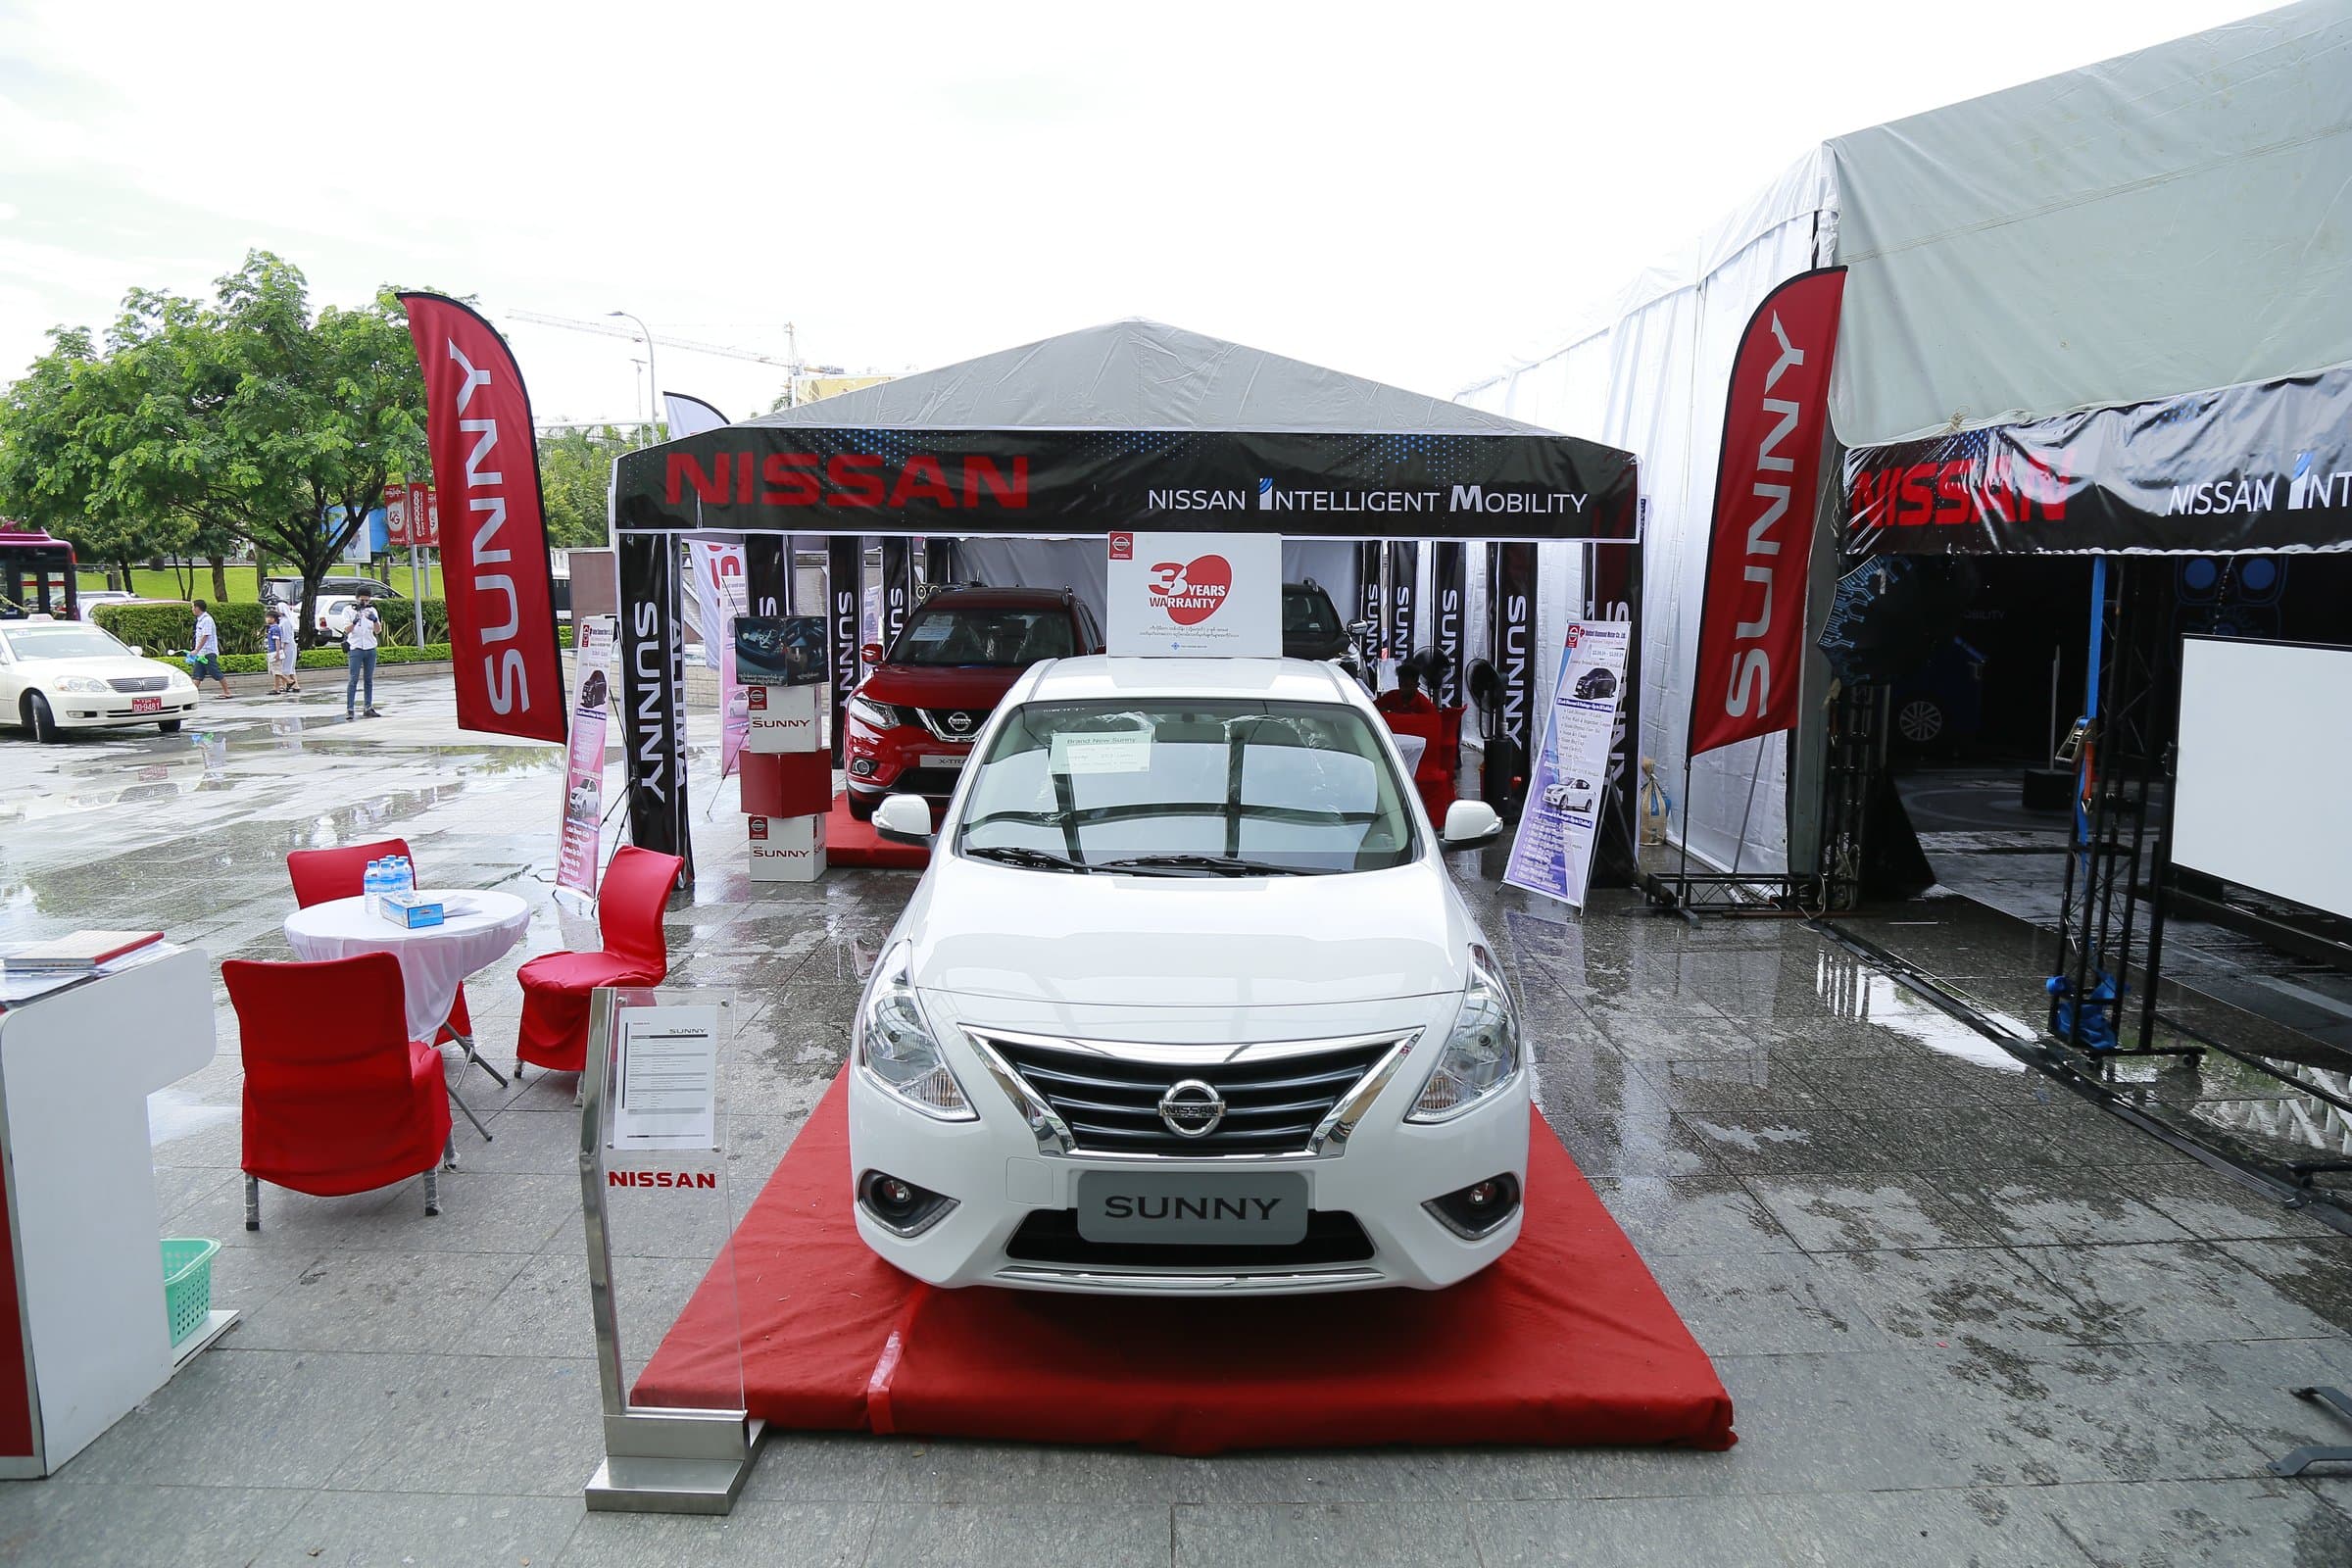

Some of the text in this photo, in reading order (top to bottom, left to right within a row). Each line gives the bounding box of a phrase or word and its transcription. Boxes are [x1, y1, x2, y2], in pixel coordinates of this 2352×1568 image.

[665, 452, 1029, 509] NISSAN
[1148, 477, 1588, 514] NISSAN INTELLIGENT MOBILITY
[1725, 310, 1804, 718] SUNNY
[1852, 447, 2076, 530] NISSAN
[2168, 477, 2276, 516] NISSAN
[448, 337, 530, 716] SUNNY
[1148, 562, 1226, 597] 3 YEARS
[1149, 597, 1216, 610] WARRANTY
[1366, 584, 1379, 674] SUNNY
[1395, 586, 1409, 665] SUN
[634, 601, 666, 804] SUNNY
[1505, 595, 1527, 751] SUNNY
[609, 1171, 716, 1189] NISSAN
[1104, 1196, 1281, 1221] SUNNY
